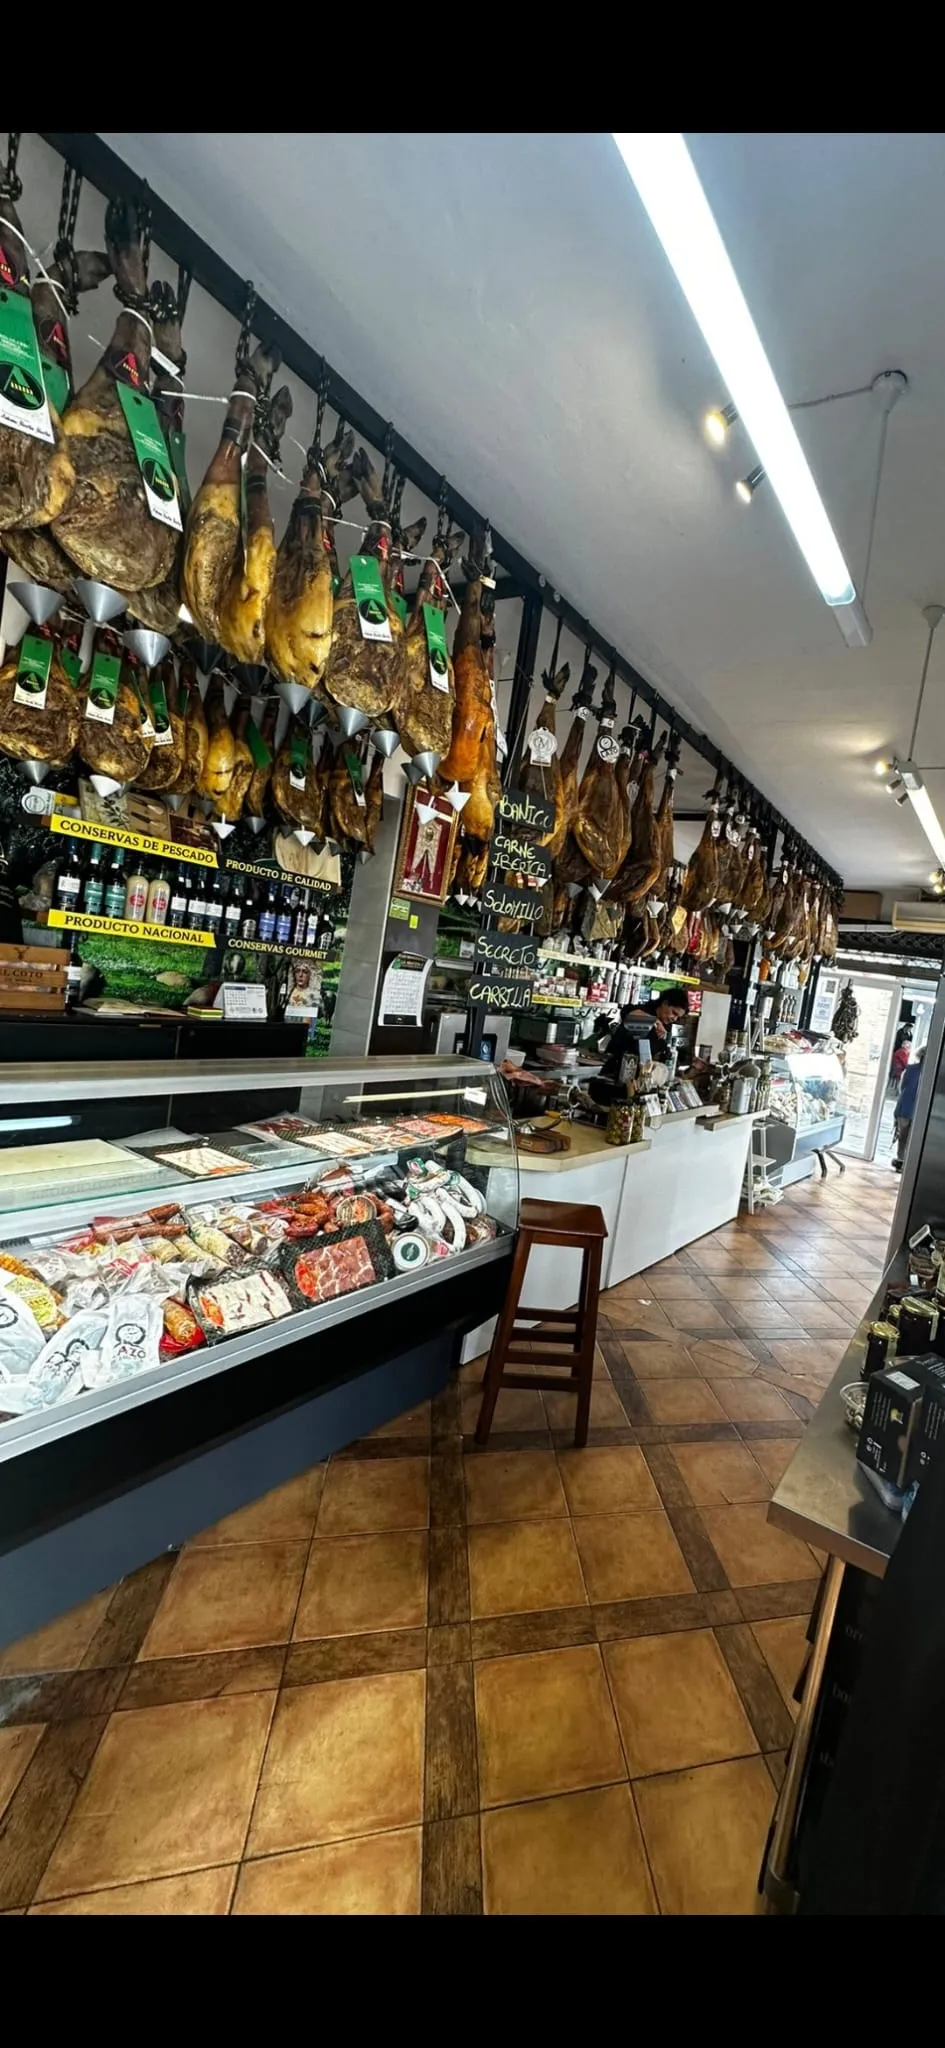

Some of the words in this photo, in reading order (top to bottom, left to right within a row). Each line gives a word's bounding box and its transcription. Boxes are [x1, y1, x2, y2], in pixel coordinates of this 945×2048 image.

[60, 820, 139, 847] CONSERVAS
[143, 839, 159, 851] DE
[162, 845, 214, 864] PESCADO
[495, 836, 536, 859] CARNE
[225, 859, 279, 879] PRODUCTO
[281, 872, 293, 882] DE
[294, 876, 332, 891] CALIDAD
[492, 852, 546, 877] IBERICA
[65, 915, 139, 935] PRODUCTO
[142, 927, 205, 943] NACIONAL
[228, 938, 284, 954] CONSERVAS
[285, 947, 328, 959] GOURMET
[477, 936, 536, 965] SECRETO
[12, 970, 43, 978] COTO
[469, 983, 531, 1009] CARRILLA
